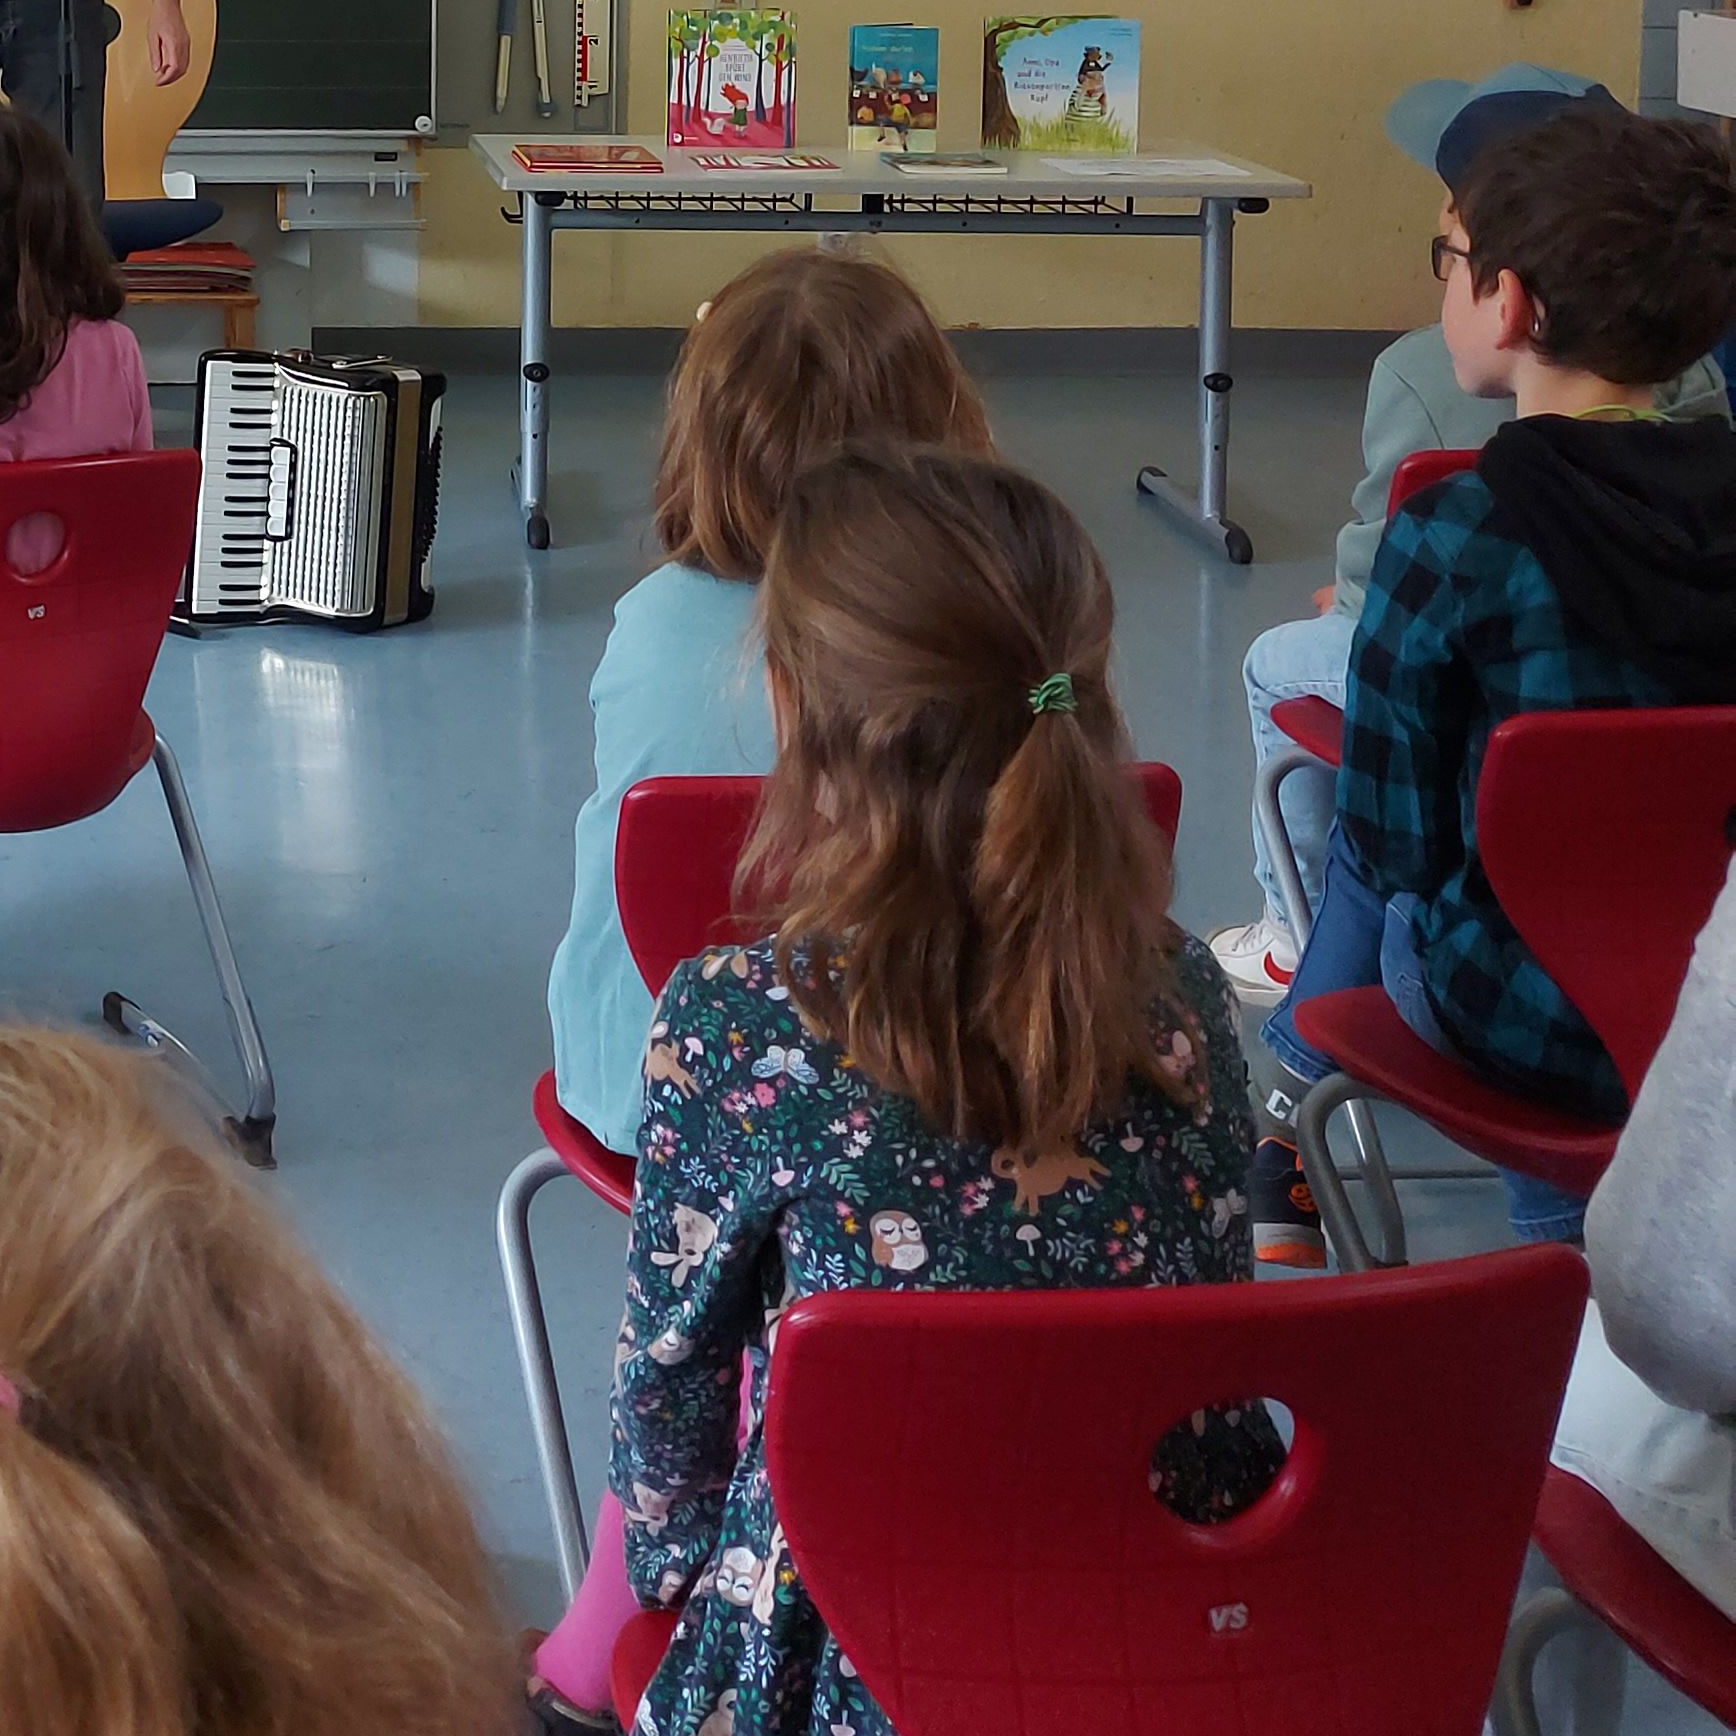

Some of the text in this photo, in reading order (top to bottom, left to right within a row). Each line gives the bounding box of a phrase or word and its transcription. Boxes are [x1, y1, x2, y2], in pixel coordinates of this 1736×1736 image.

[589, 38, 599, 46] 2
[27, 605, 45, 620] VS
[1209, 1602, 1249, 1633] VS
